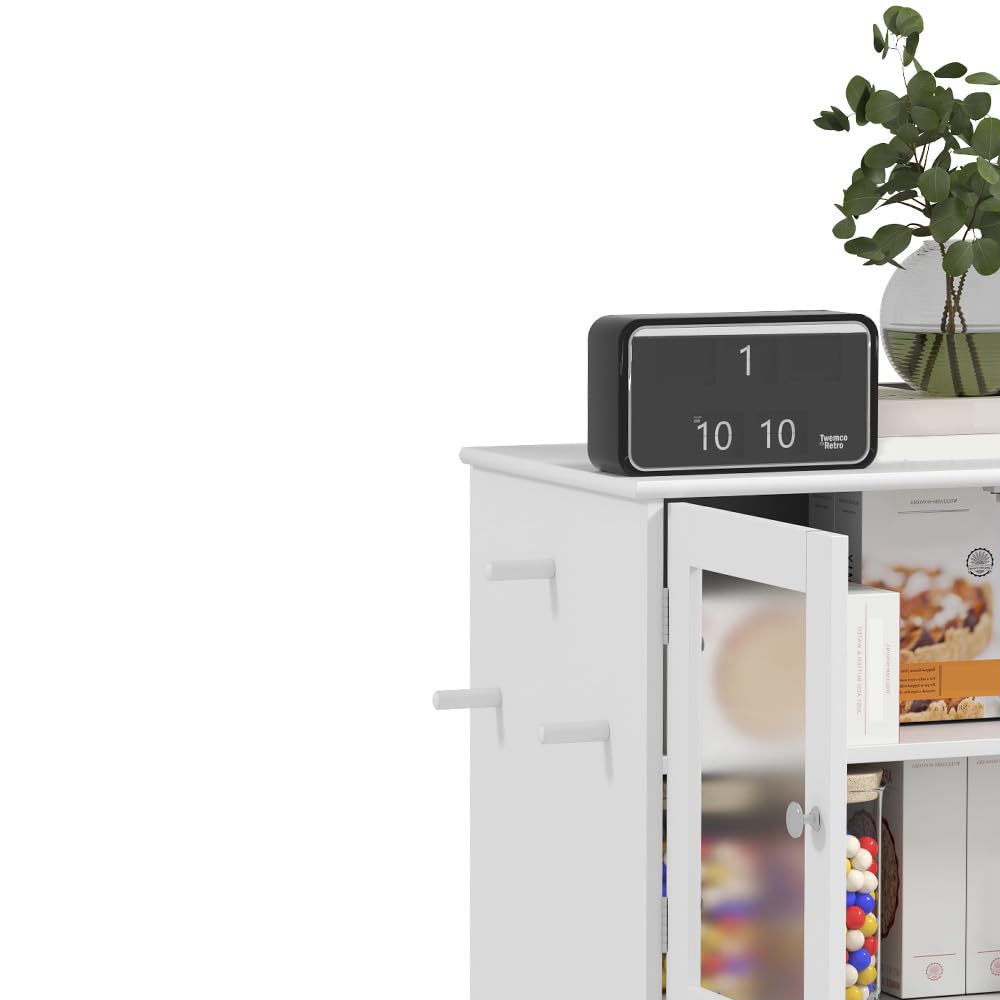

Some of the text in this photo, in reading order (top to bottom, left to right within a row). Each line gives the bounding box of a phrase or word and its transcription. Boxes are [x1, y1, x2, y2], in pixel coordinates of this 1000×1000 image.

[739, 344, 752, 376] 1
[697, 418, 796, 451] 10 10
[819, 433, 849, 442] Twemco
[824, 441, 844, 450] Retro
